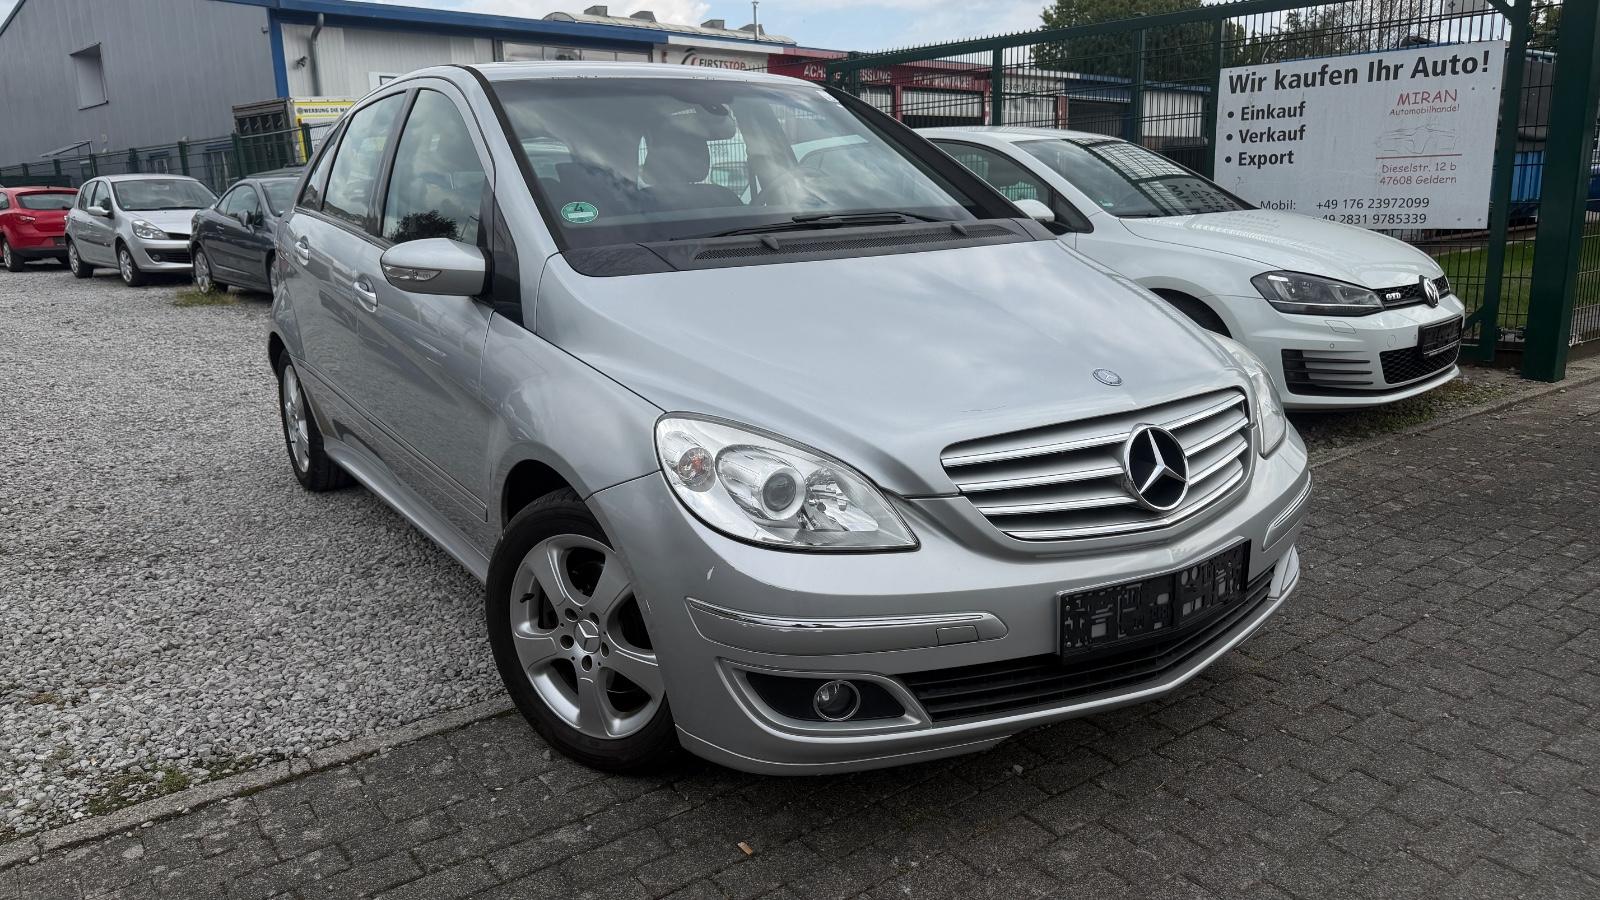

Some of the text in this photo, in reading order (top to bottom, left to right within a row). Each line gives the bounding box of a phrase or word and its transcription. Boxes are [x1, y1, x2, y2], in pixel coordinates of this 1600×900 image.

[1229, 50, 1490, 95] Wir kaufen Ihr Auto!
[1397, 89, 1458, 106] MIRAN
[1240, 101, 1307, 121] Einkauf
[1389, 104, 1460, 116] Automobilhandel
[1239, 125, 1307, 144] Verkauf
[1238, 150, 1294, 169] Export
[1381, 162, 1457, 174] Dieselstr. 12 b
[1379, 174, 1457, 185] 47608 Geldern
[1260, 200, 1296, 210] Mobil:
[1316, 198, 1430, 210] +49 176 23972099
[1339, 214, 1368, 225] 2831
[1372, 213, 1427, 224] 9785339
